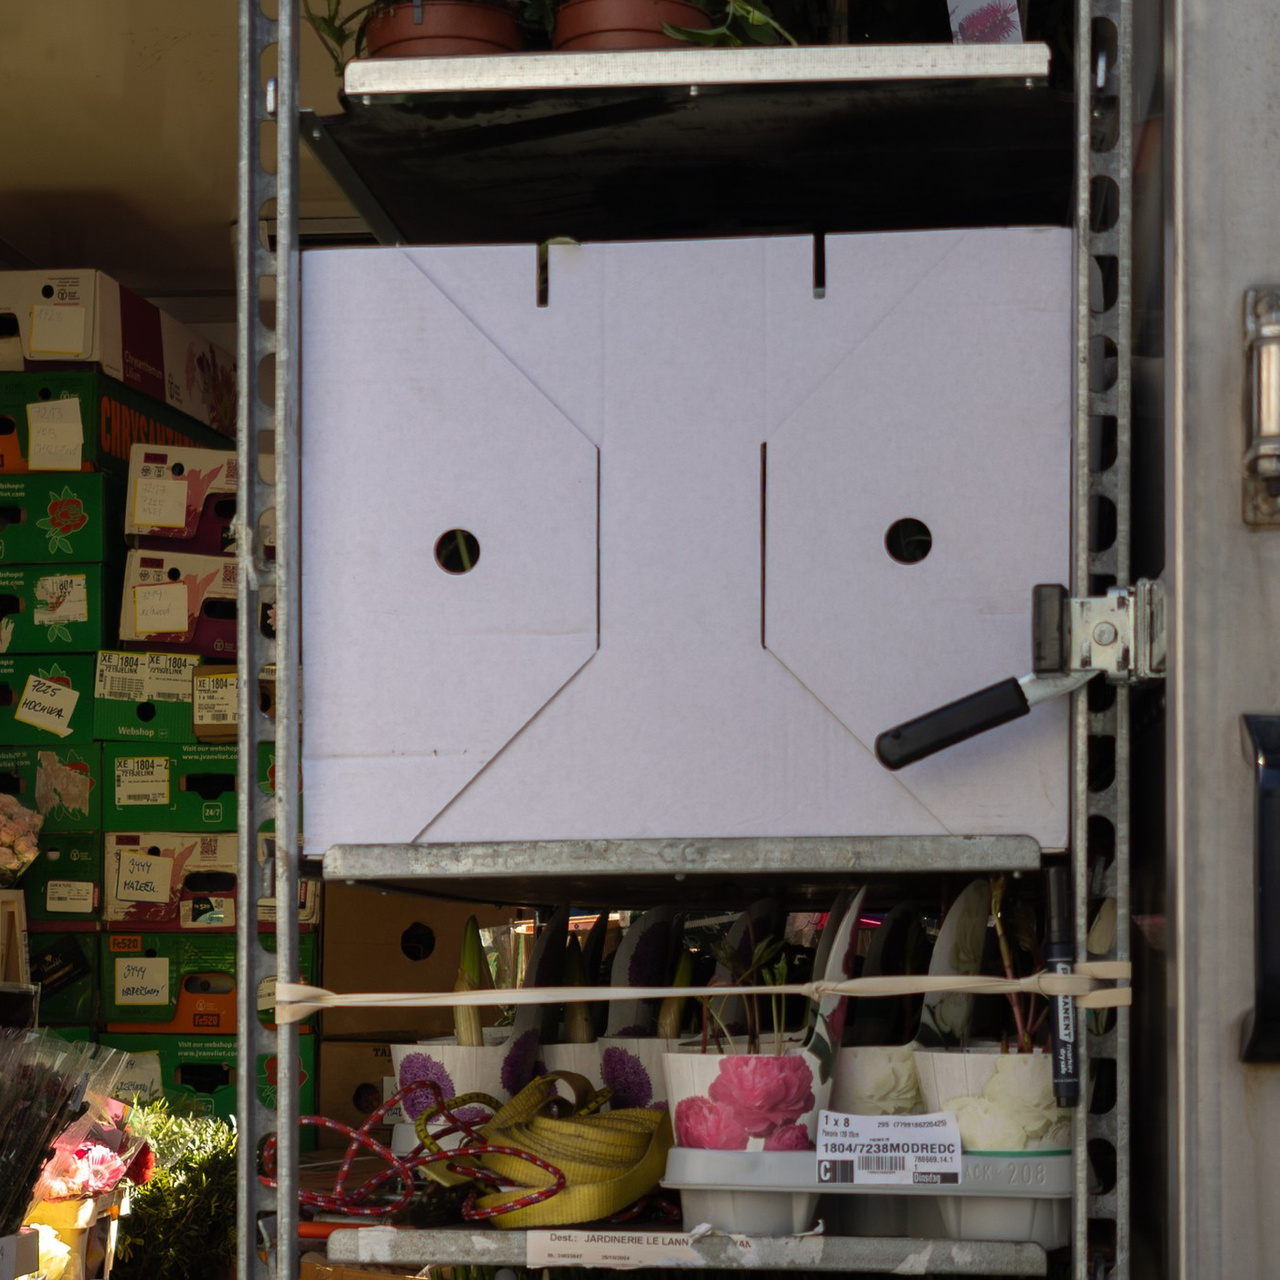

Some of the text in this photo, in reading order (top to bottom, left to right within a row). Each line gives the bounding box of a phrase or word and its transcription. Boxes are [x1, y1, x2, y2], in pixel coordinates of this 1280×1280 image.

[101, 654, 113, 663] XE
[149, 655, 160, 664] XE
[198, 679, 207, 688] XE
[118, 726, 155, 737] Webshop
[182, 753, 237, 761] www.jvanvliet.co
[117, 760, 128, 769] XE
[205, 808, 220, 816] 24/7
[112, 938, 138, 949] Fc520
[1060, 967, 1072, 1039] PANENT
[193, 1015, 218, 1025] Fc520
[178, 1050, 237, 1058] www.jvanvliet.co
[824, 1115, 829, 1125] 1
[833, 1119, 839, 1127] x
[844, 1118, 850, 1128] 8
[823, 1142, 956, 1154] 1804/7238MODREDC
[820, 1161, 830, 1181] C
[914, 1173, 941, 1184] Dinsdag
[549, 1232, 577, 1243] Dest.:
[584, 1234, 644, 1245] JARDINERIE
[646, 1236, 659, 1245] LE
[661, 1236, 689, 1246] LANN
